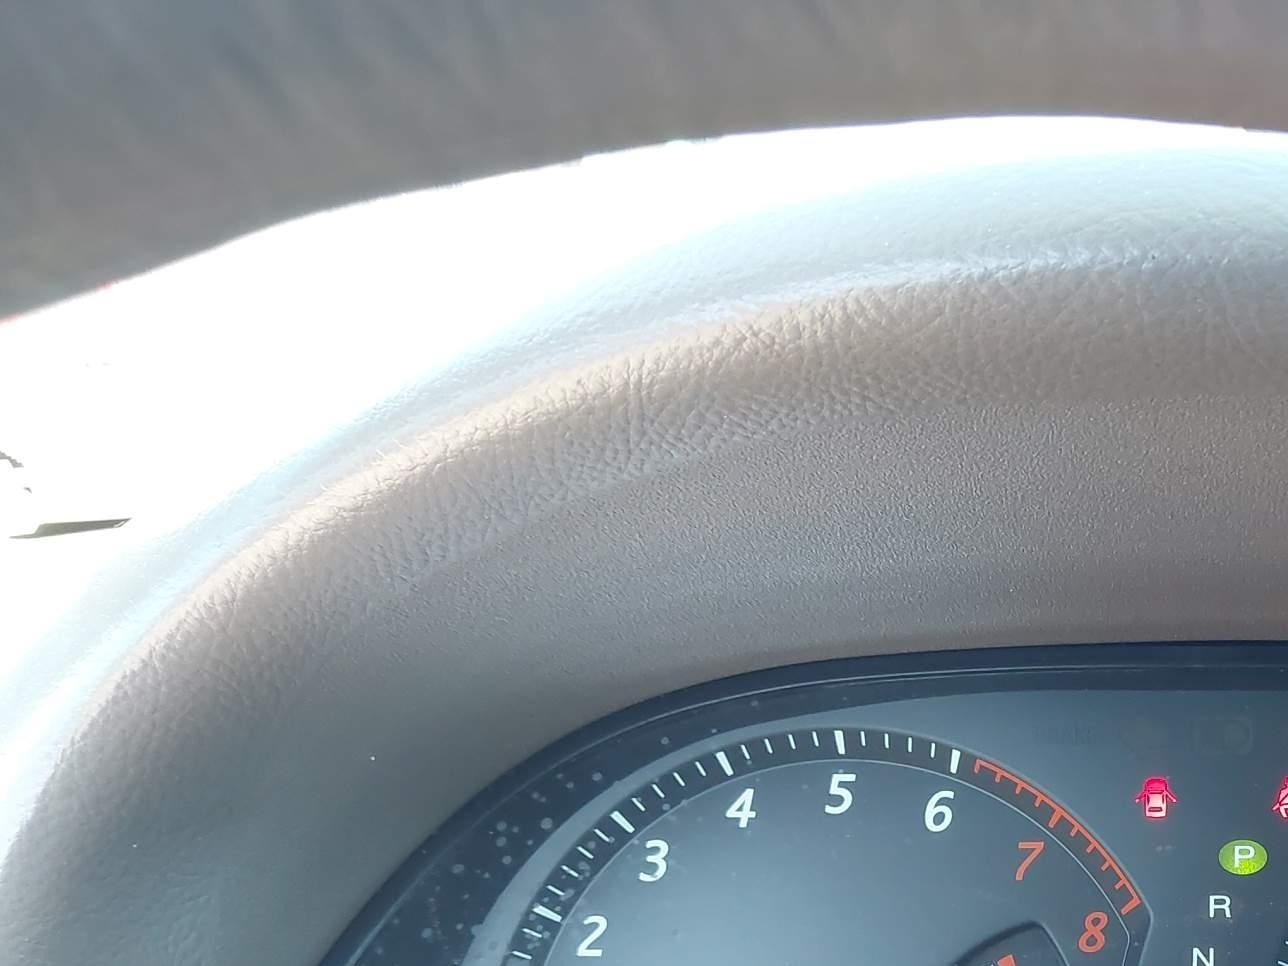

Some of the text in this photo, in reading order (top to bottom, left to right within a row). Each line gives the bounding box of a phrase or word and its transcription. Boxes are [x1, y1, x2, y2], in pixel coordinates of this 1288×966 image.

[725, 788, 757, 828] 4
[824, 773, 857, 815] 5
[924, 790, 955, 832] 6
[638, 839, 669, 882] 3
[1015, 841, 1045, 880] 7
[1233, 845, 1256, 868] P
[1208, 895, 1232, 918] R
[576, 915, 608, 957] 2
[1077, 911, 1108, 953] 8
